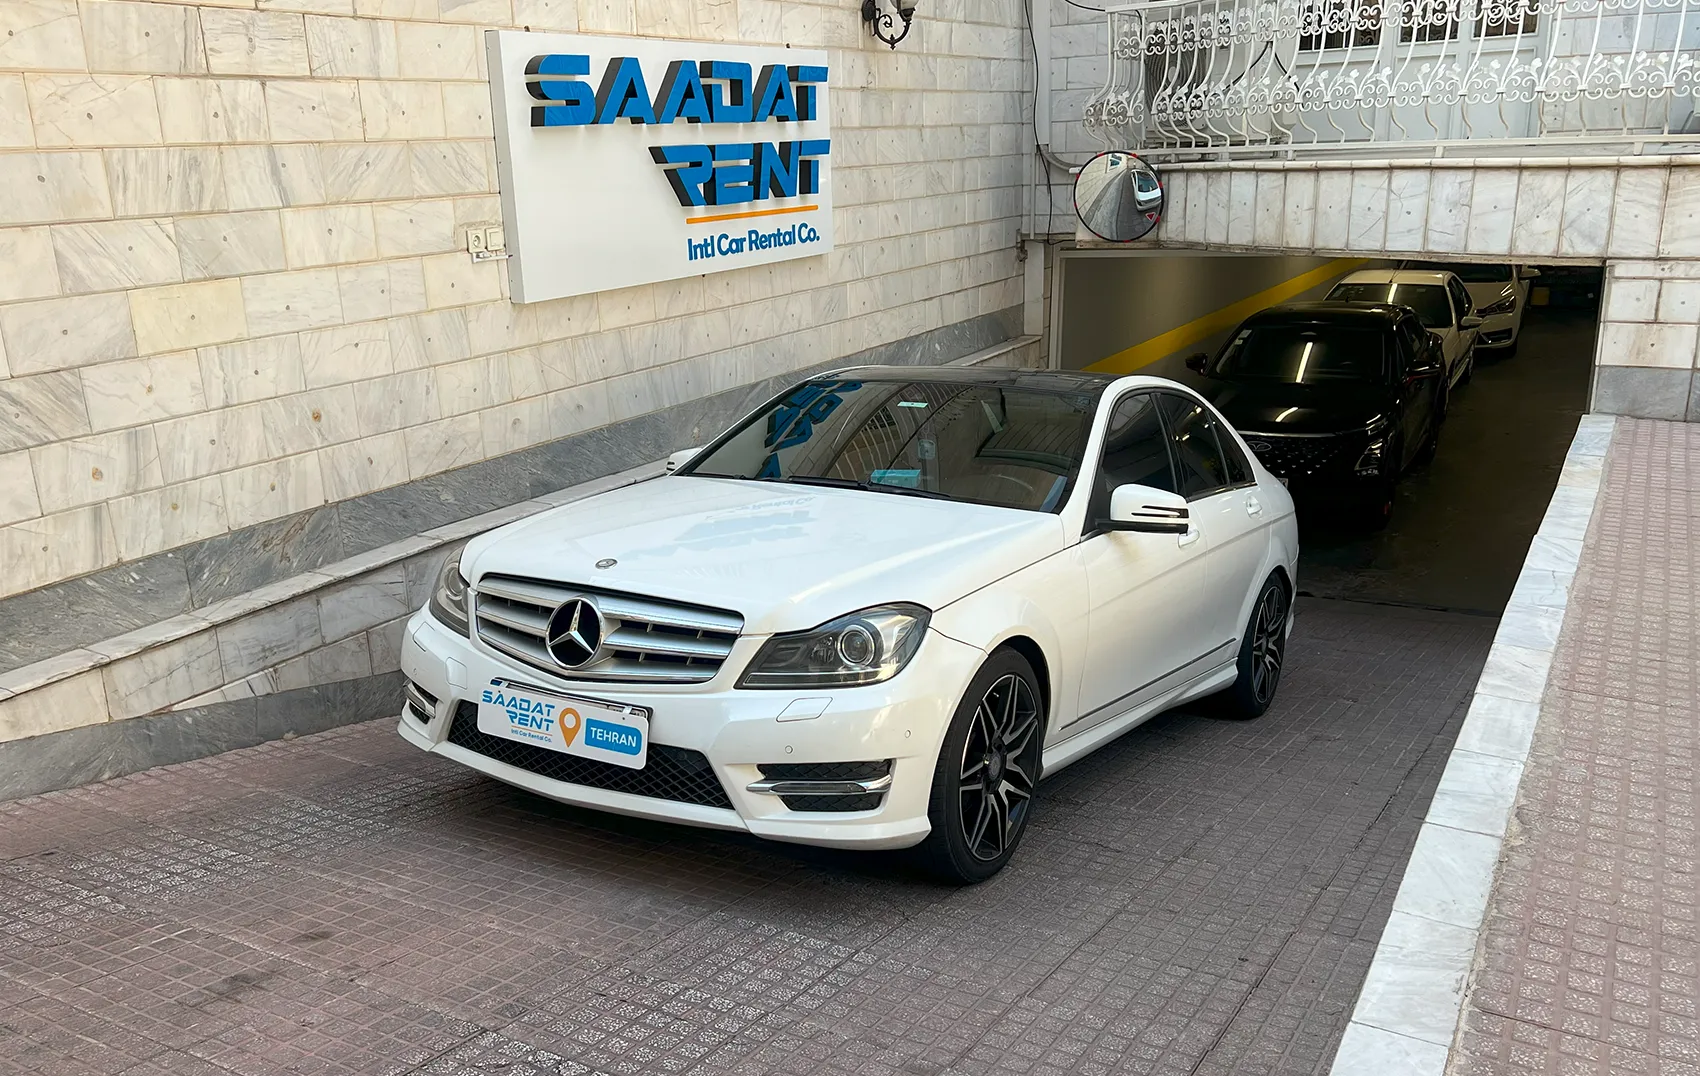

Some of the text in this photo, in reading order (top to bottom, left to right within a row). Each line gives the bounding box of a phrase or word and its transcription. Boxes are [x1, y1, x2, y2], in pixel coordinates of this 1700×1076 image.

[524, 54, 828, 127] SAADAT
[648, 139, 831, 207] RENT
[687, 222, 820, 261] Intl Car Rental Co.
[482, 690, 555, 717] SAADAT
[506, 709, 554, 732] RENT
[590, 727, 637, 748] TEHRAN
